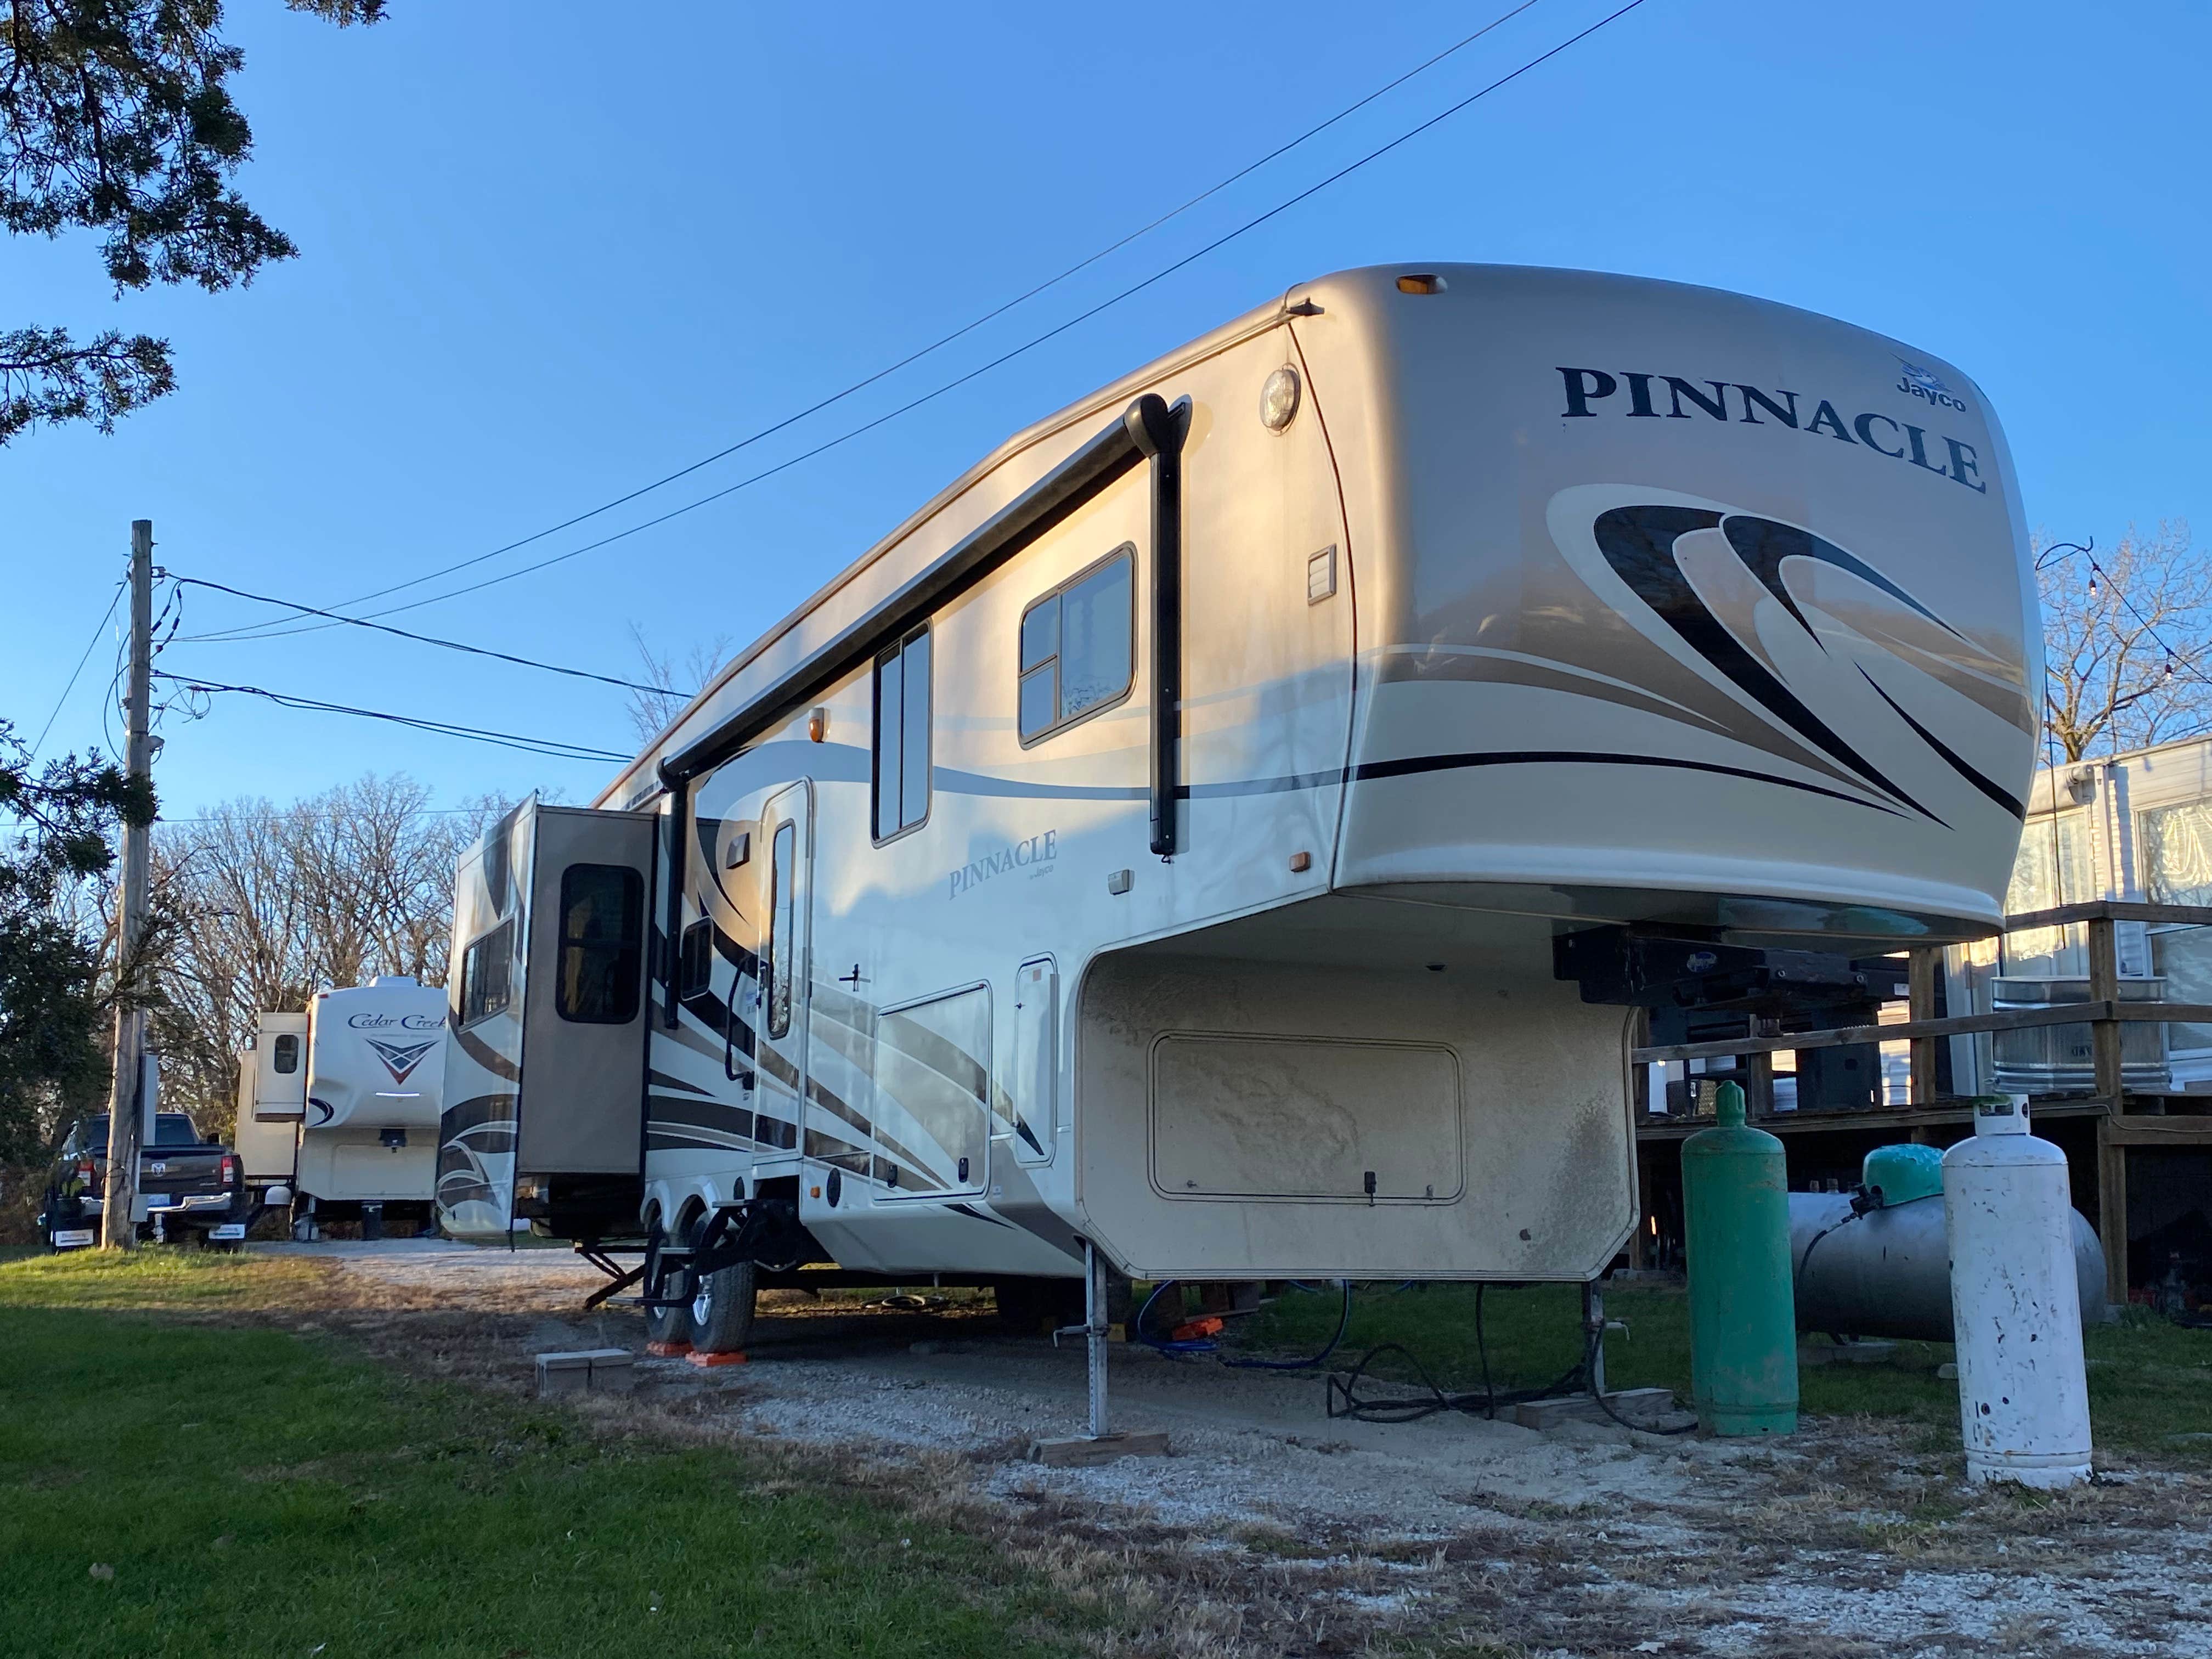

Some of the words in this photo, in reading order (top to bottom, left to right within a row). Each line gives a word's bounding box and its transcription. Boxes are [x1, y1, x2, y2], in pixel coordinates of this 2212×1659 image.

[1897, 377, 1966, 412] Jayco
[1555, 366, 1987, 494] PINNACLE
[949, 830, 1057, 900] PINNACLE
[347, 1013, 398, 1029] Cedar
